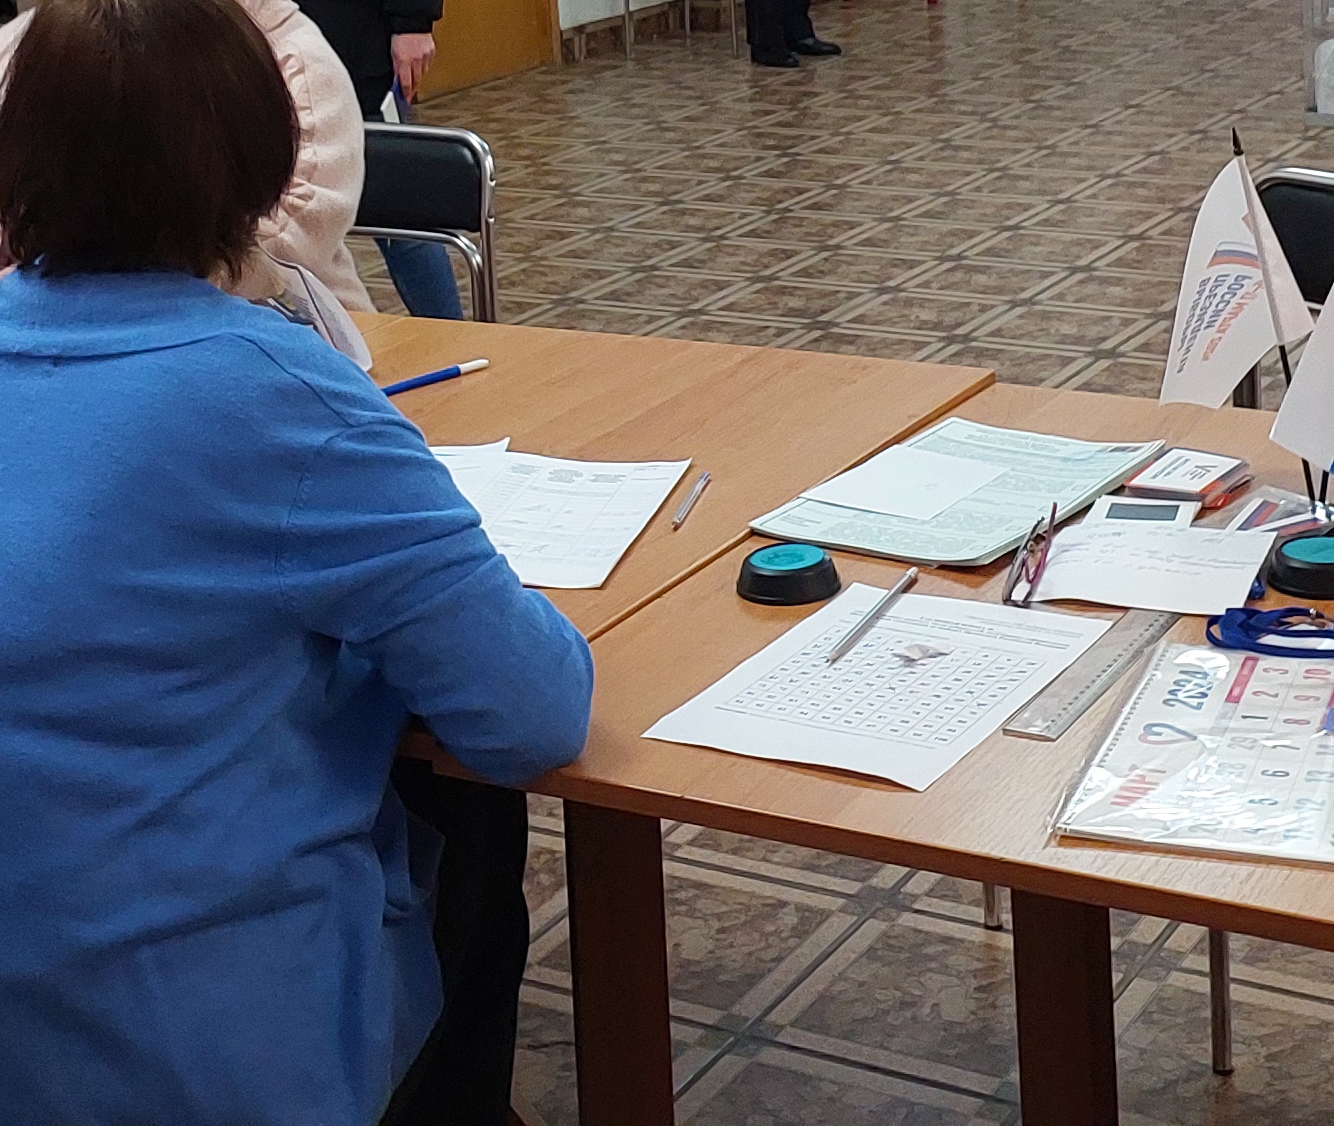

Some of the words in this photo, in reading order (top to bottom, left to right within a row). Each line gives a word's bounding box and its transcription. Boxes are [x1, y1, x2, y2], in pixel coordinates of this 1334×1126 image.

[1262, 667, 1289, 675] 3
[1303, 668, 1332, 680] 10
[1162, 669, 1214, 711] 2024
[1251, 690, 1279, 699] 2
[1293, 694, 1321, 702] 9
[1261, 769, 1290, 778] 6
[1248, 798, 1278, 806] 5
